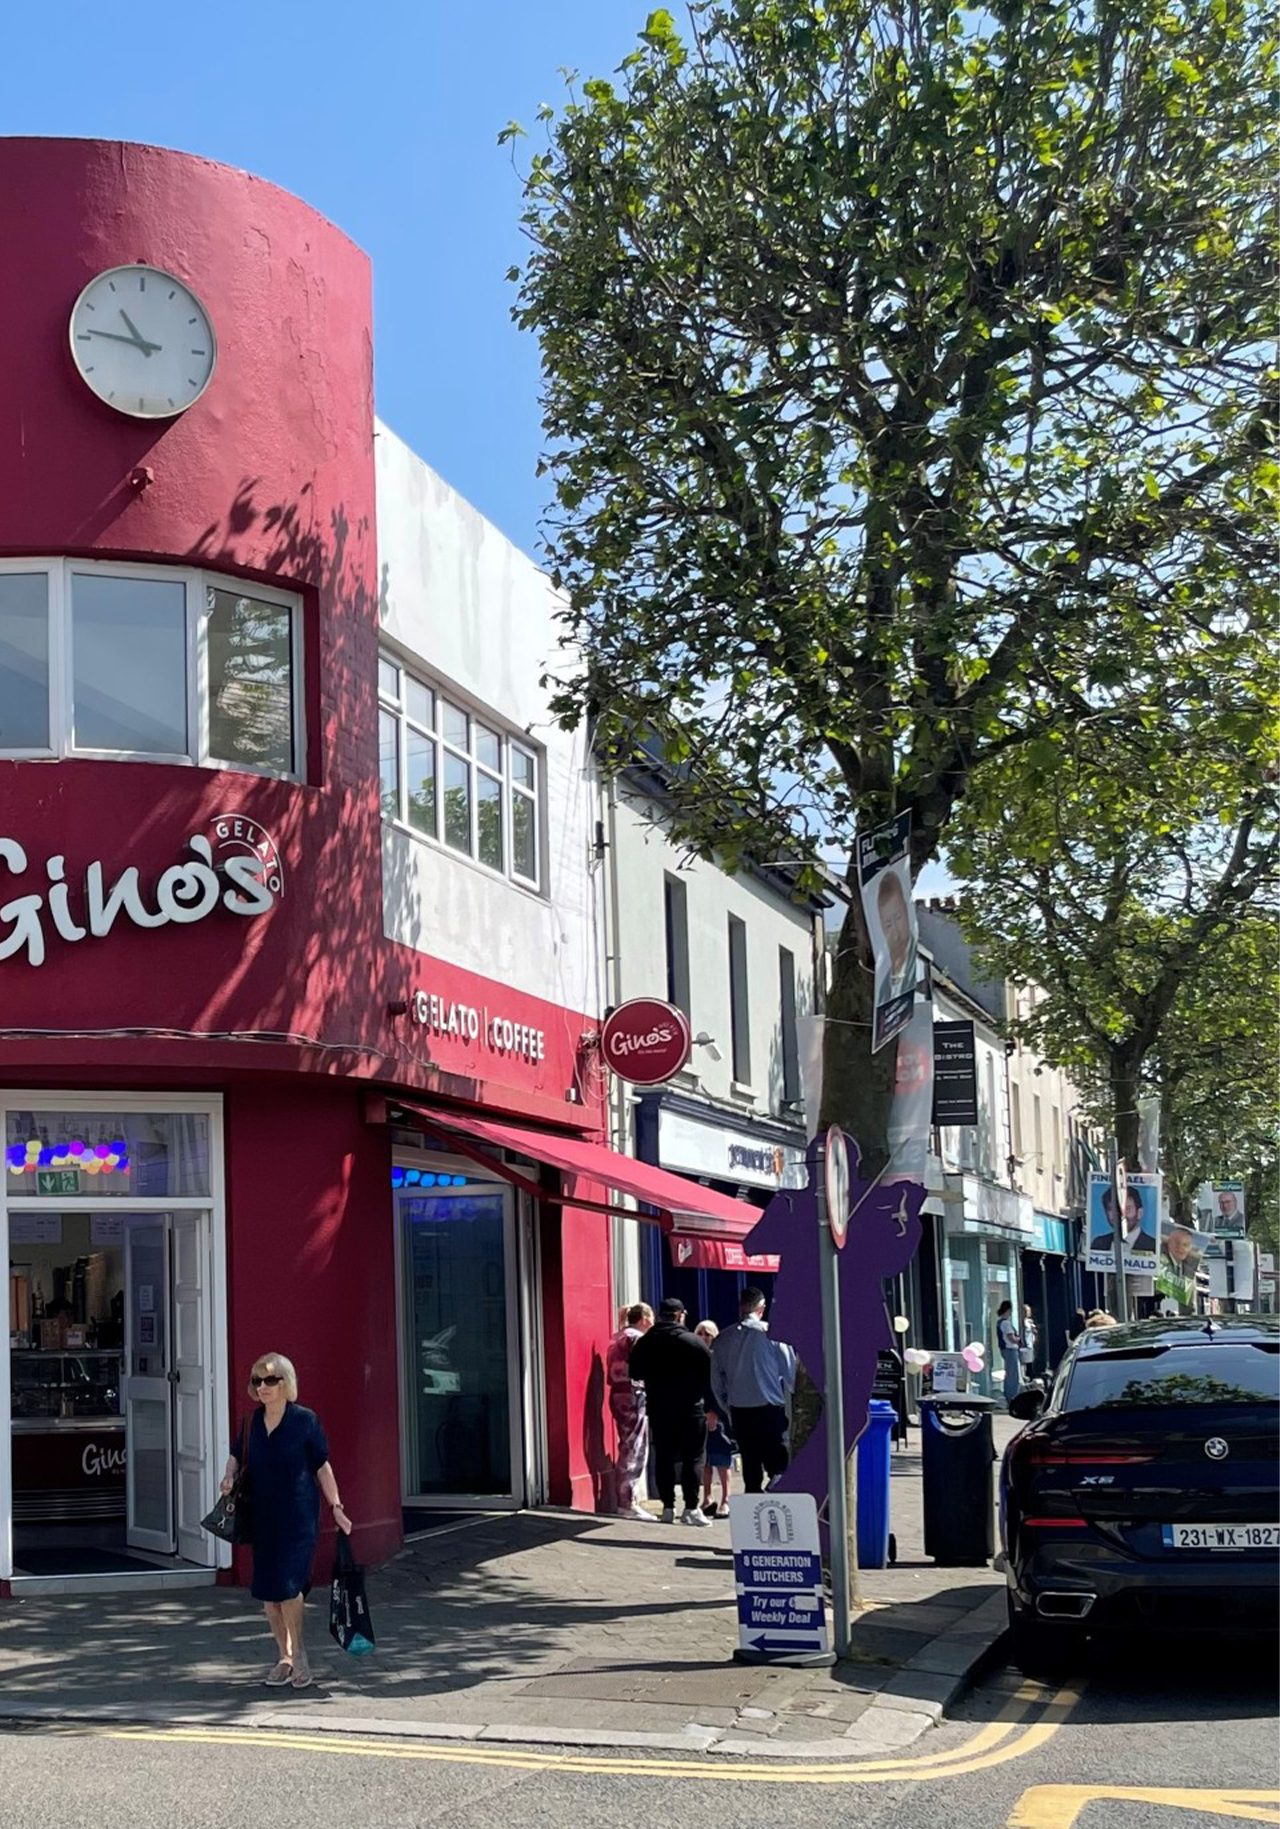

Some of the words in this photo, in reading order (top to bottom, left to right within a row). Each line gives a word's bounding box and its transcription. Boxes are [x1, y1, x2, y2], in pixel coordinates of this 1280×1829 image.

[216, 820, 280, 893] GELATO
[416, 990, 479, 1040] GELATO
[492, 1016, 545, 1060] COFFEE
[610, 1026, 673, 1056] Gino's
[1089, 1256, 1157, 1270] McDNALD
[1179, 1527, 1280, 1547] 231-WX-1827
[752, 1556, 811, 1568] GENERATION
[753, 1571, 804, 1583] BUTCHERS
[752, 1596, 767, 1609] Try
[770, 1598, 786, 1608] our
[751, 1611, 786, 1626] Weekly
[788, 1612, 811, 1624] Deal
